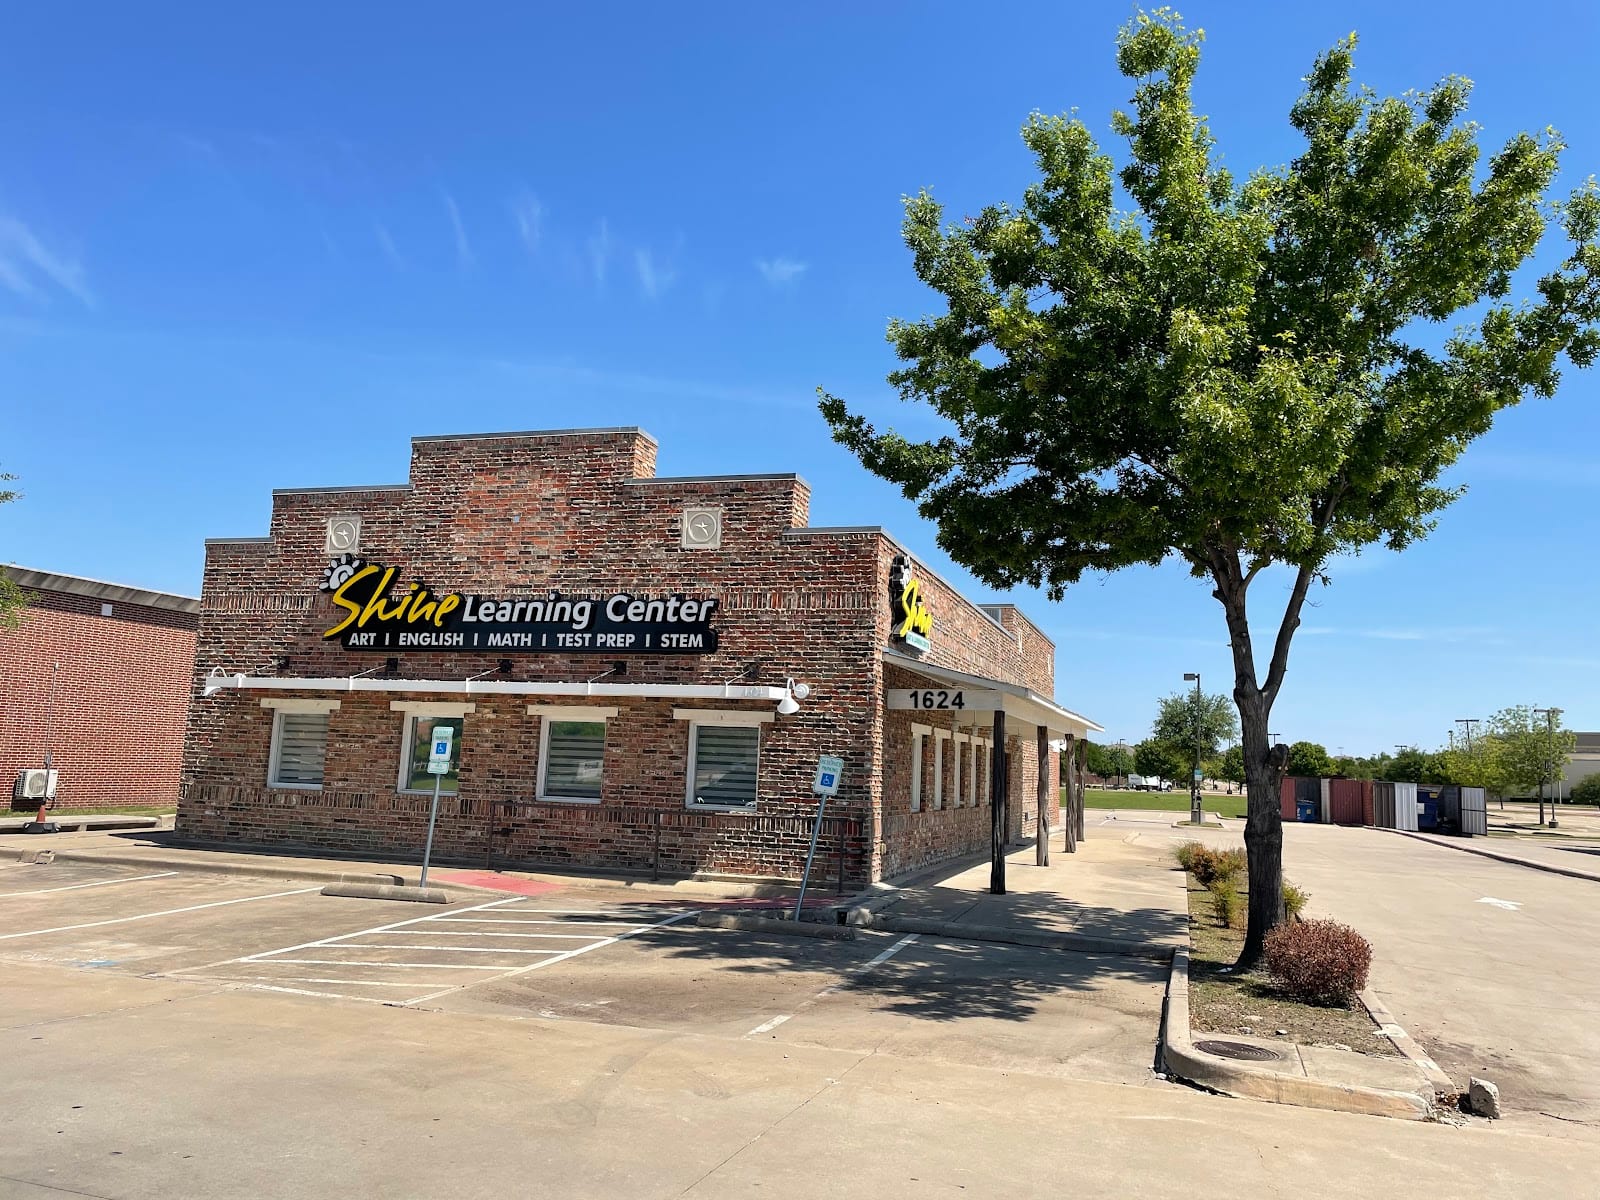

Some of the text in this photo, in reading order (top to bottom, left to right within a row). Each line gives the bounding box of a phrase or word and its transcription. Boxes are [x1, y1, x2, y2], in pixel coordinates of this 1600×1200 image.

[324, 564, 715, 637] Shine Learning Center
[348, 632, 377, 646] ART
[398, 632, 464, 646] ENGLISH
[487, 633, 532, 647] MATH
[556, 633, 593, 647] TEST
[596, 633, 636, 648] PREP
[660, 634, 704, 648] STEM
[909, 690, 965, 710] 1624
